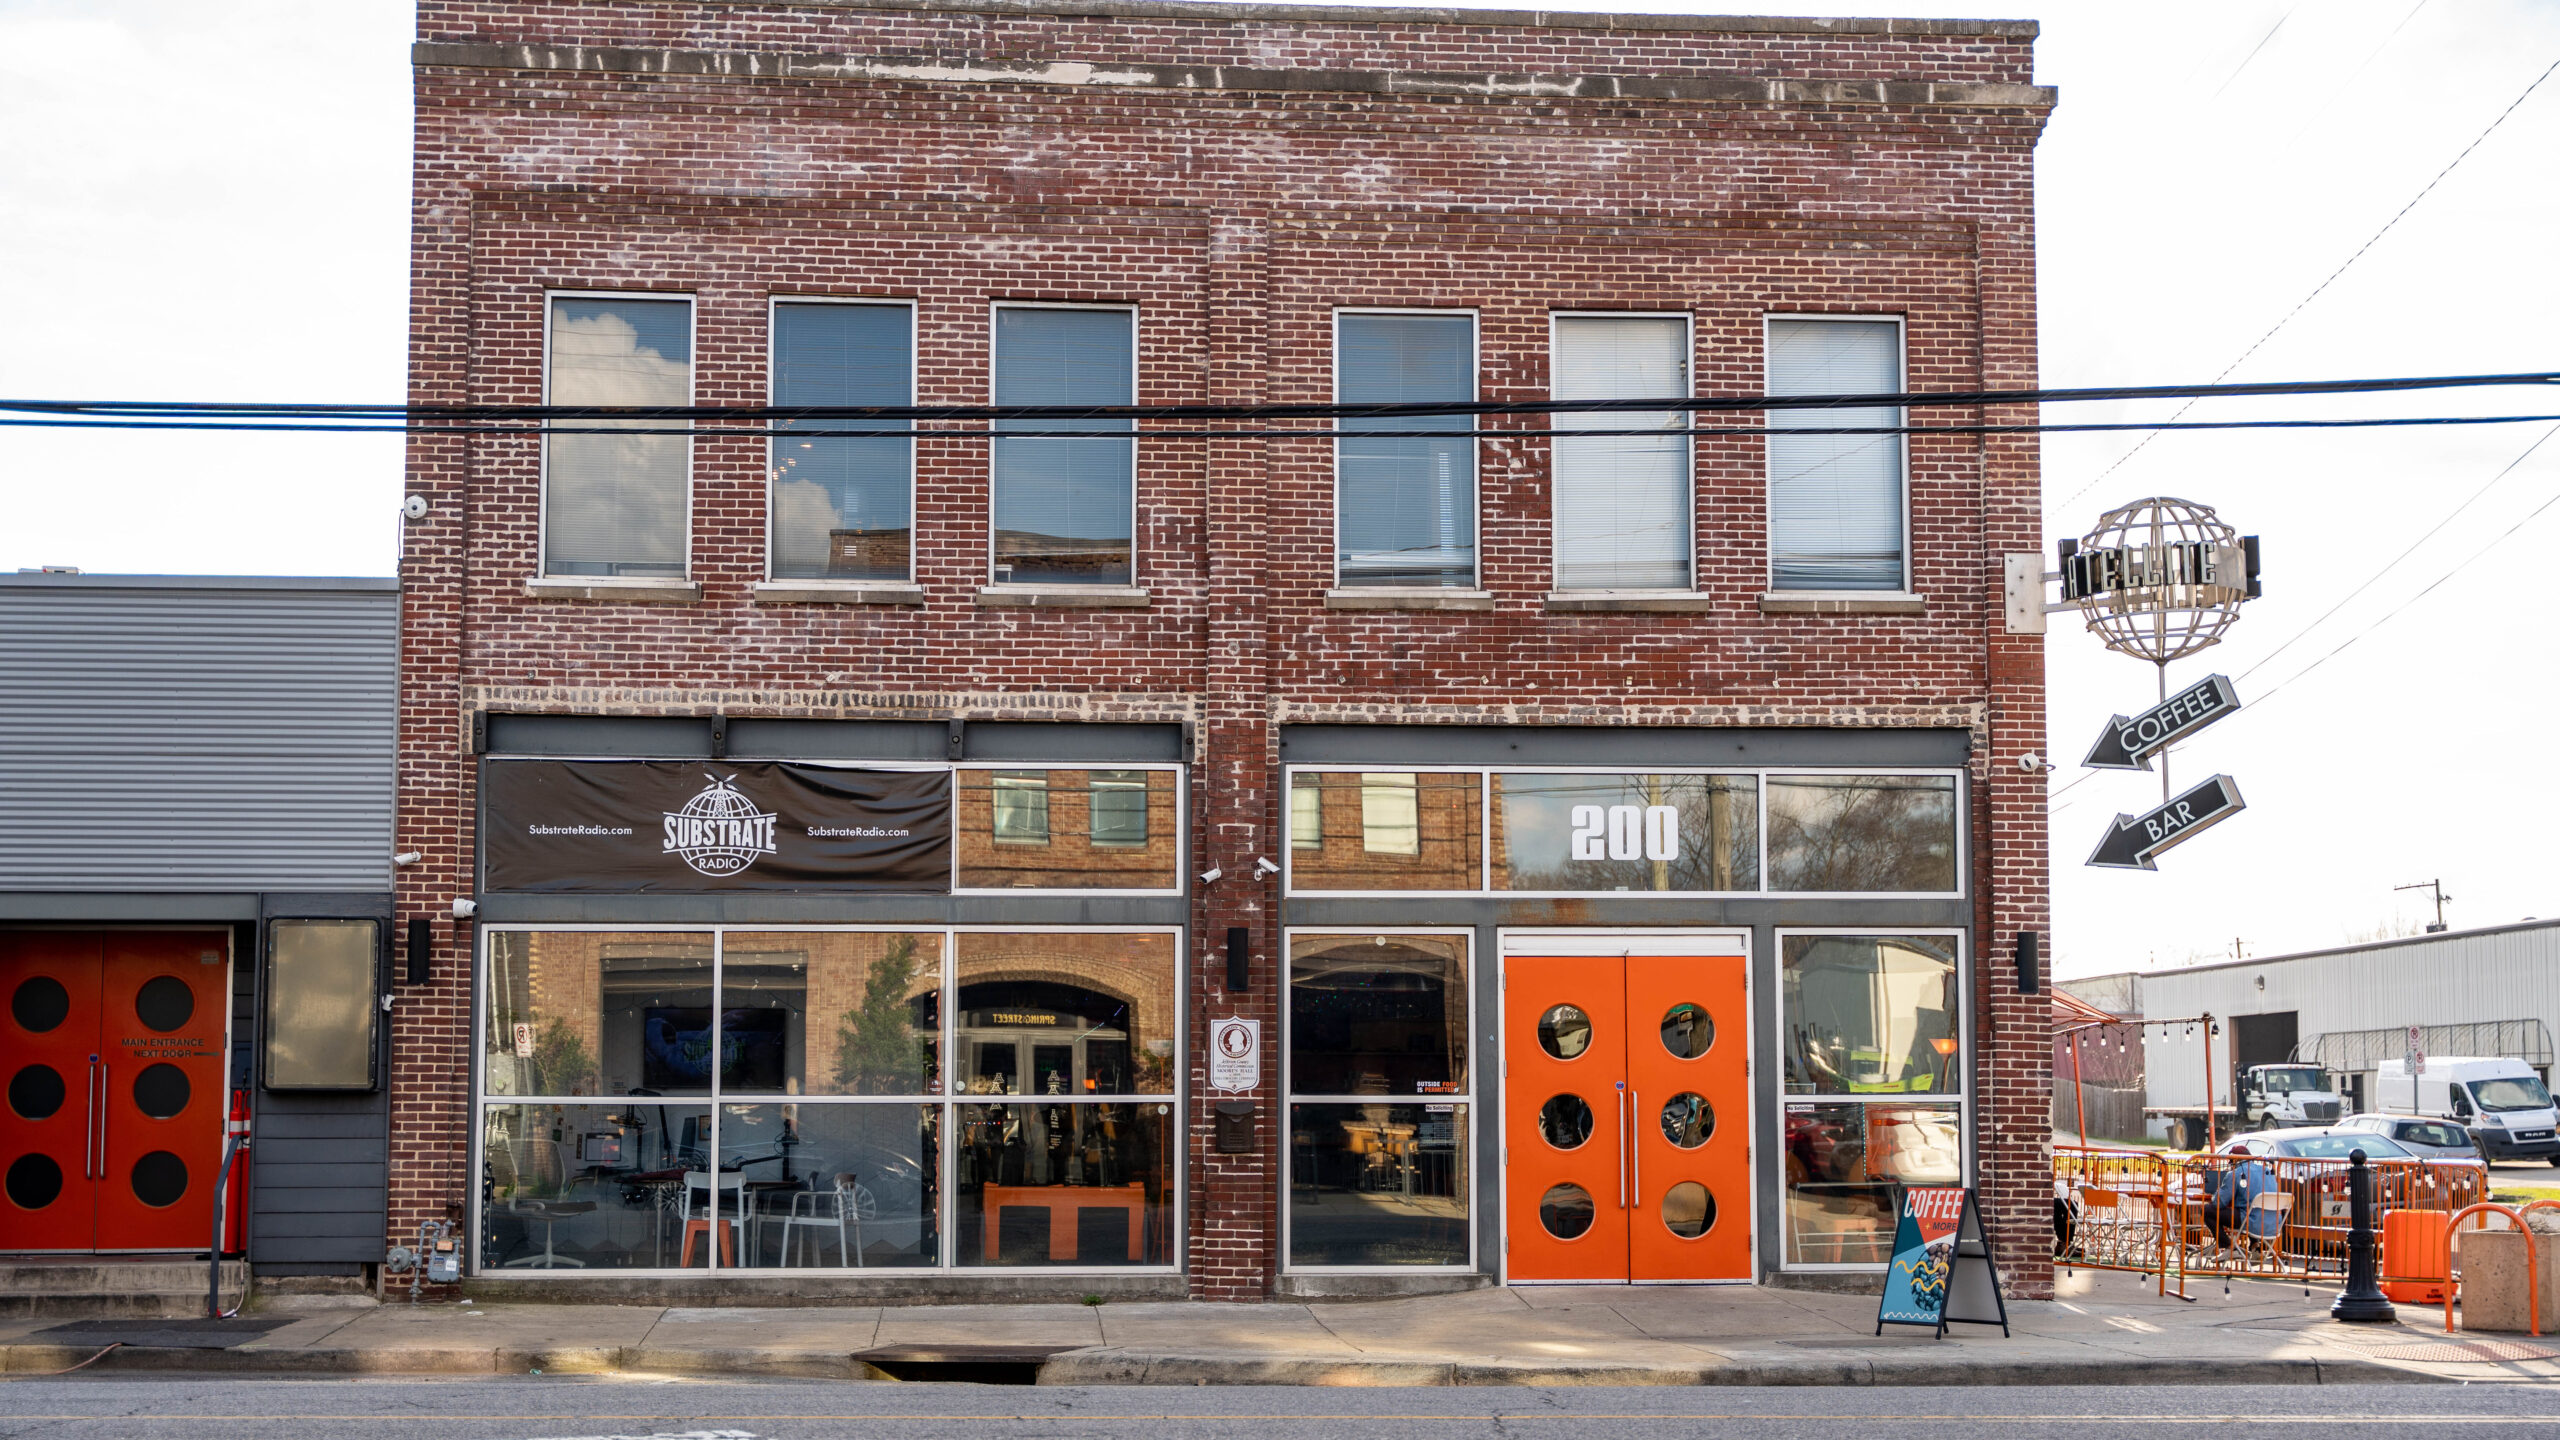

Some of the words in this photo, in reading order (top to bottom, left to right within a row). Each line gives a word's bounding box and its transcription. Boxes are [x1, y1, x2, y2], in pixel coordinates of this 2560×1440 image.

[2120, 685, 2214, 753] COFFEE
[2145, 801, 2195, 842] BAR
[529, 824, 632, 836] SubstrateRadio.com
[663, 816, 776, 850] SUBSTRATE
[807, 826, 909, 838] SubstrateRadio.com
[1571, 805, 1679, 861] 200
[698, 857, 741, 871] RADIO
[121, 1038, 147, 1047] MAIN
[150, 1039, 204, 1047] ENTRANCE
[133, 1049, 159, 1057] NEXT
[162, 1049, 192, 1058] DOOR
[1903, 1189, 1965, 1219] COFFEE
[1932, 1222, 1957, 1231] MORE
